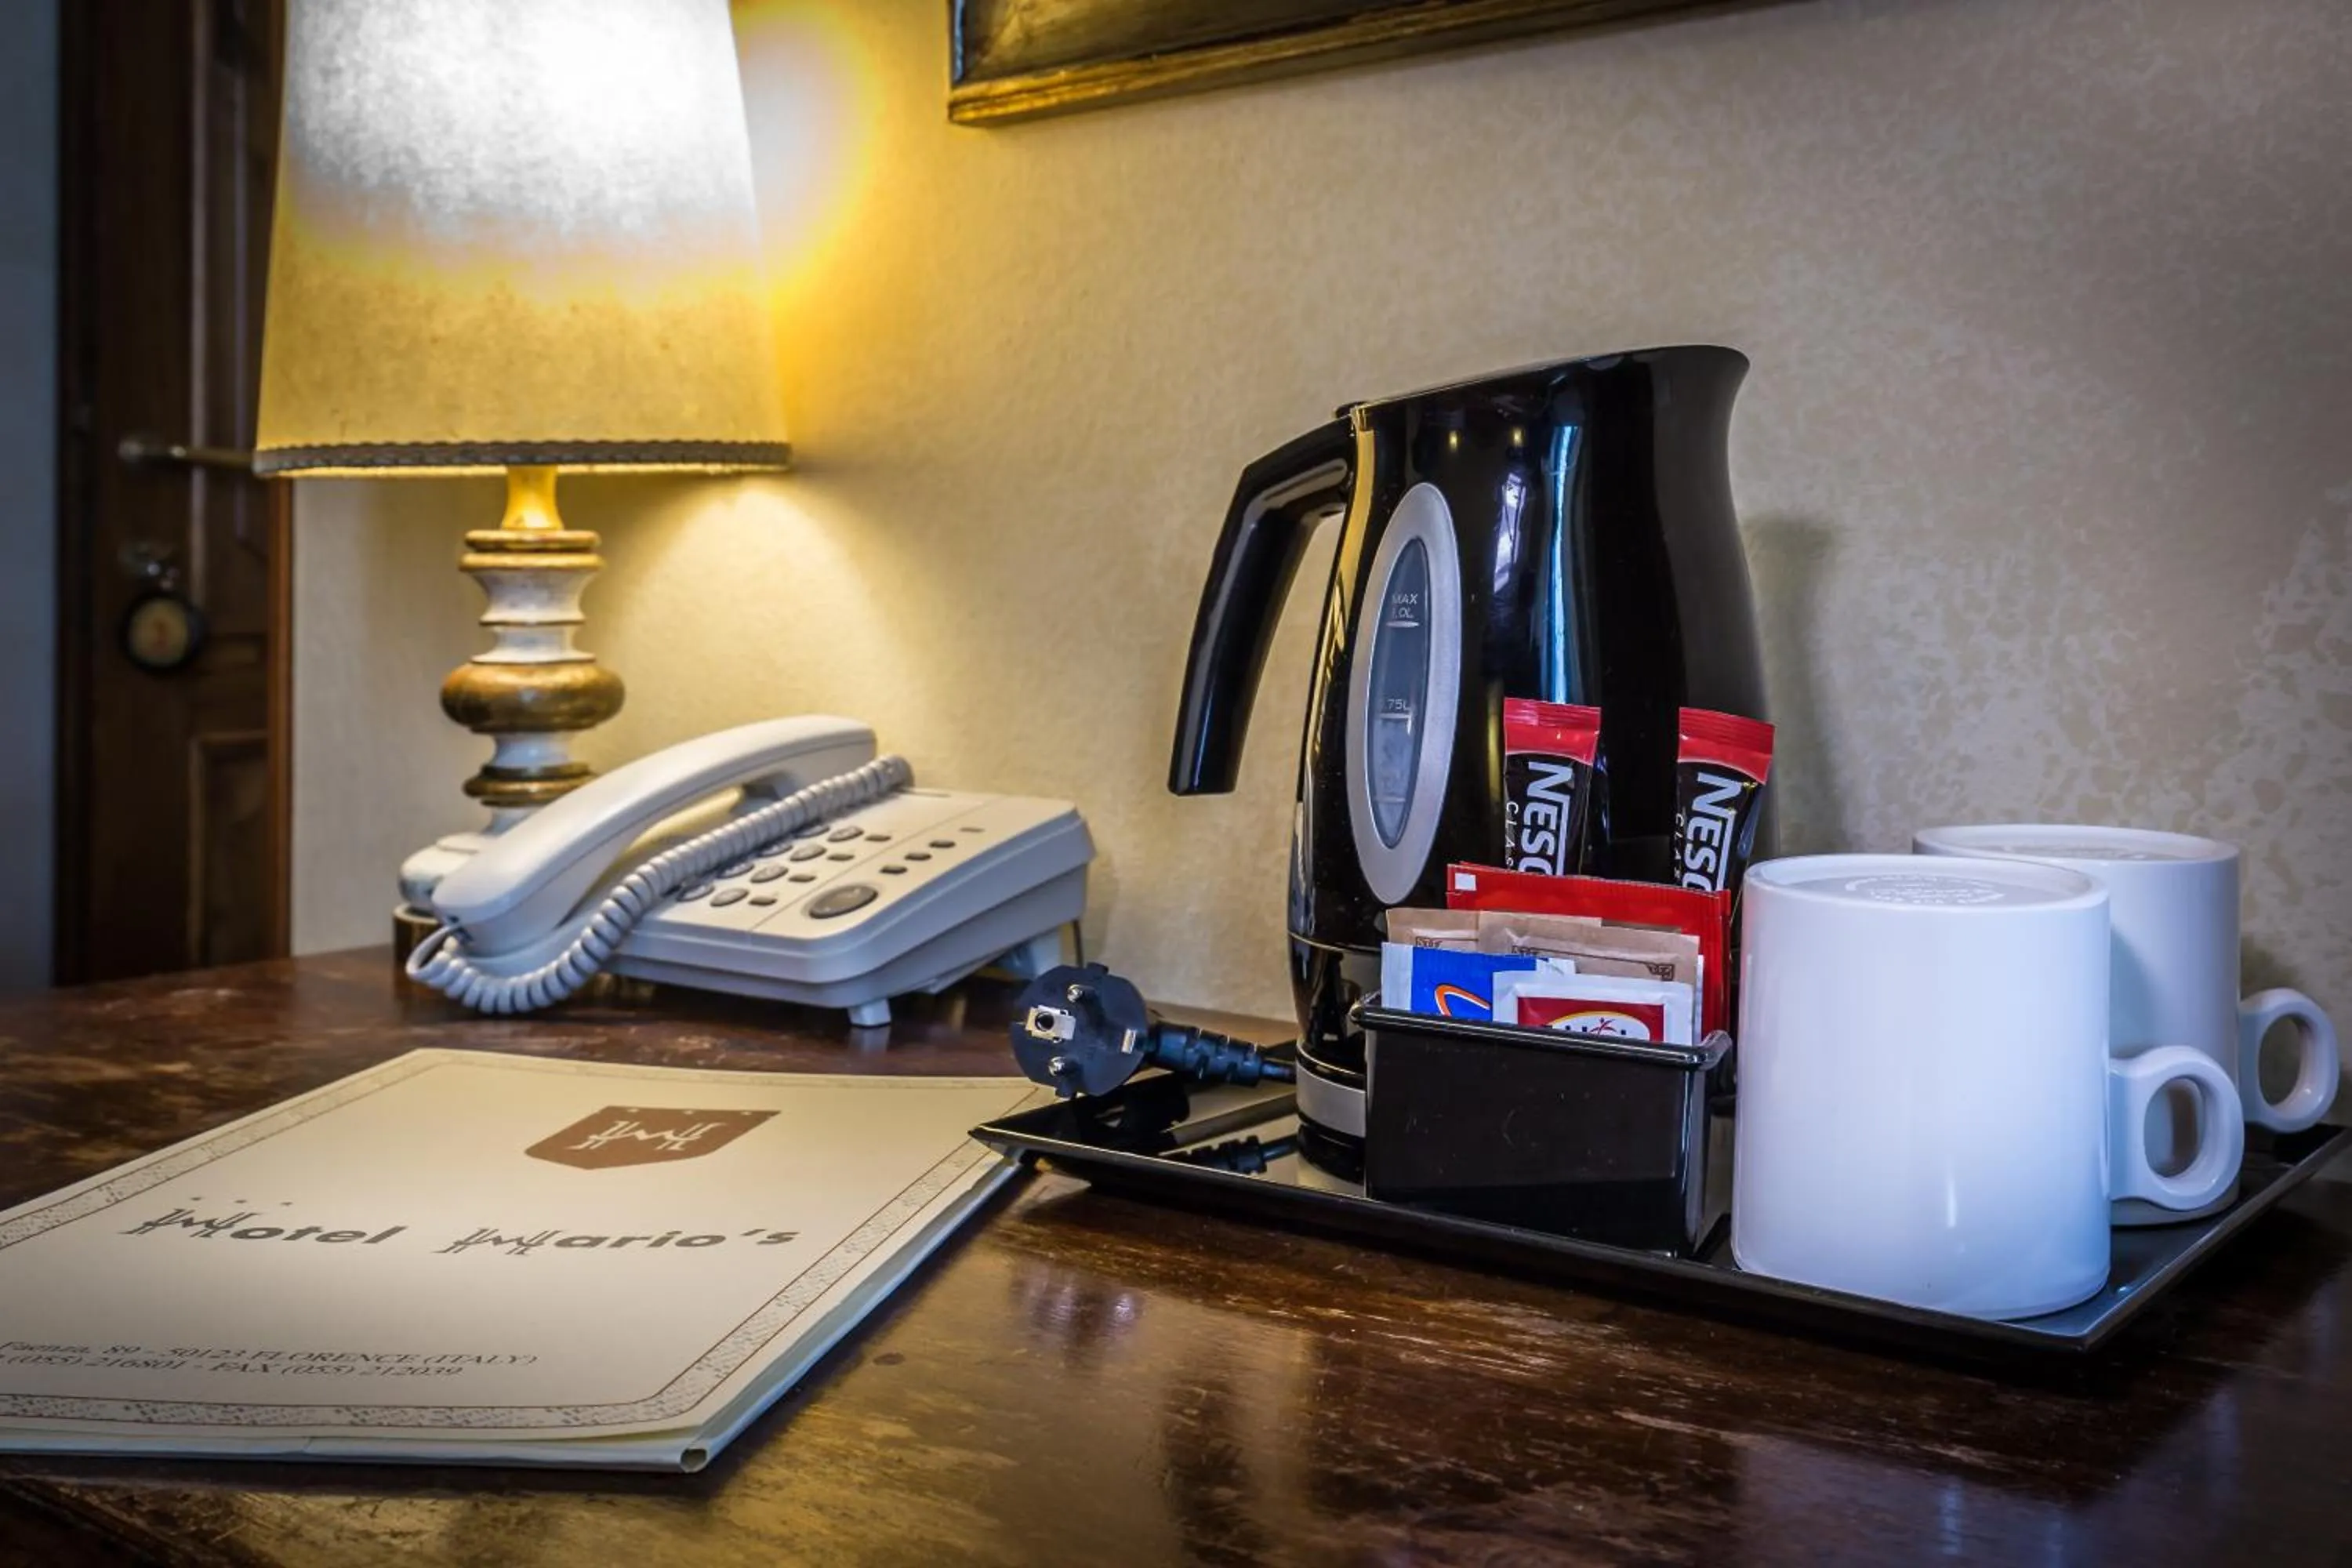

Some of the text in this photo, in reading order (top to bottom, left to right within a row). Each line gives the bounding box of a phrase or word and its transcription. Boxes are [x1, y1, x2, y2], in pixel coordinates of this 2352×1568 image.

[1392, 593, 1419, 606] MAX
[249, 1349, 422, 1365] FLORENCE
[423, 1353, 539, 1366] (ITALY)
[208, 1361, 281, 1374] FAX
